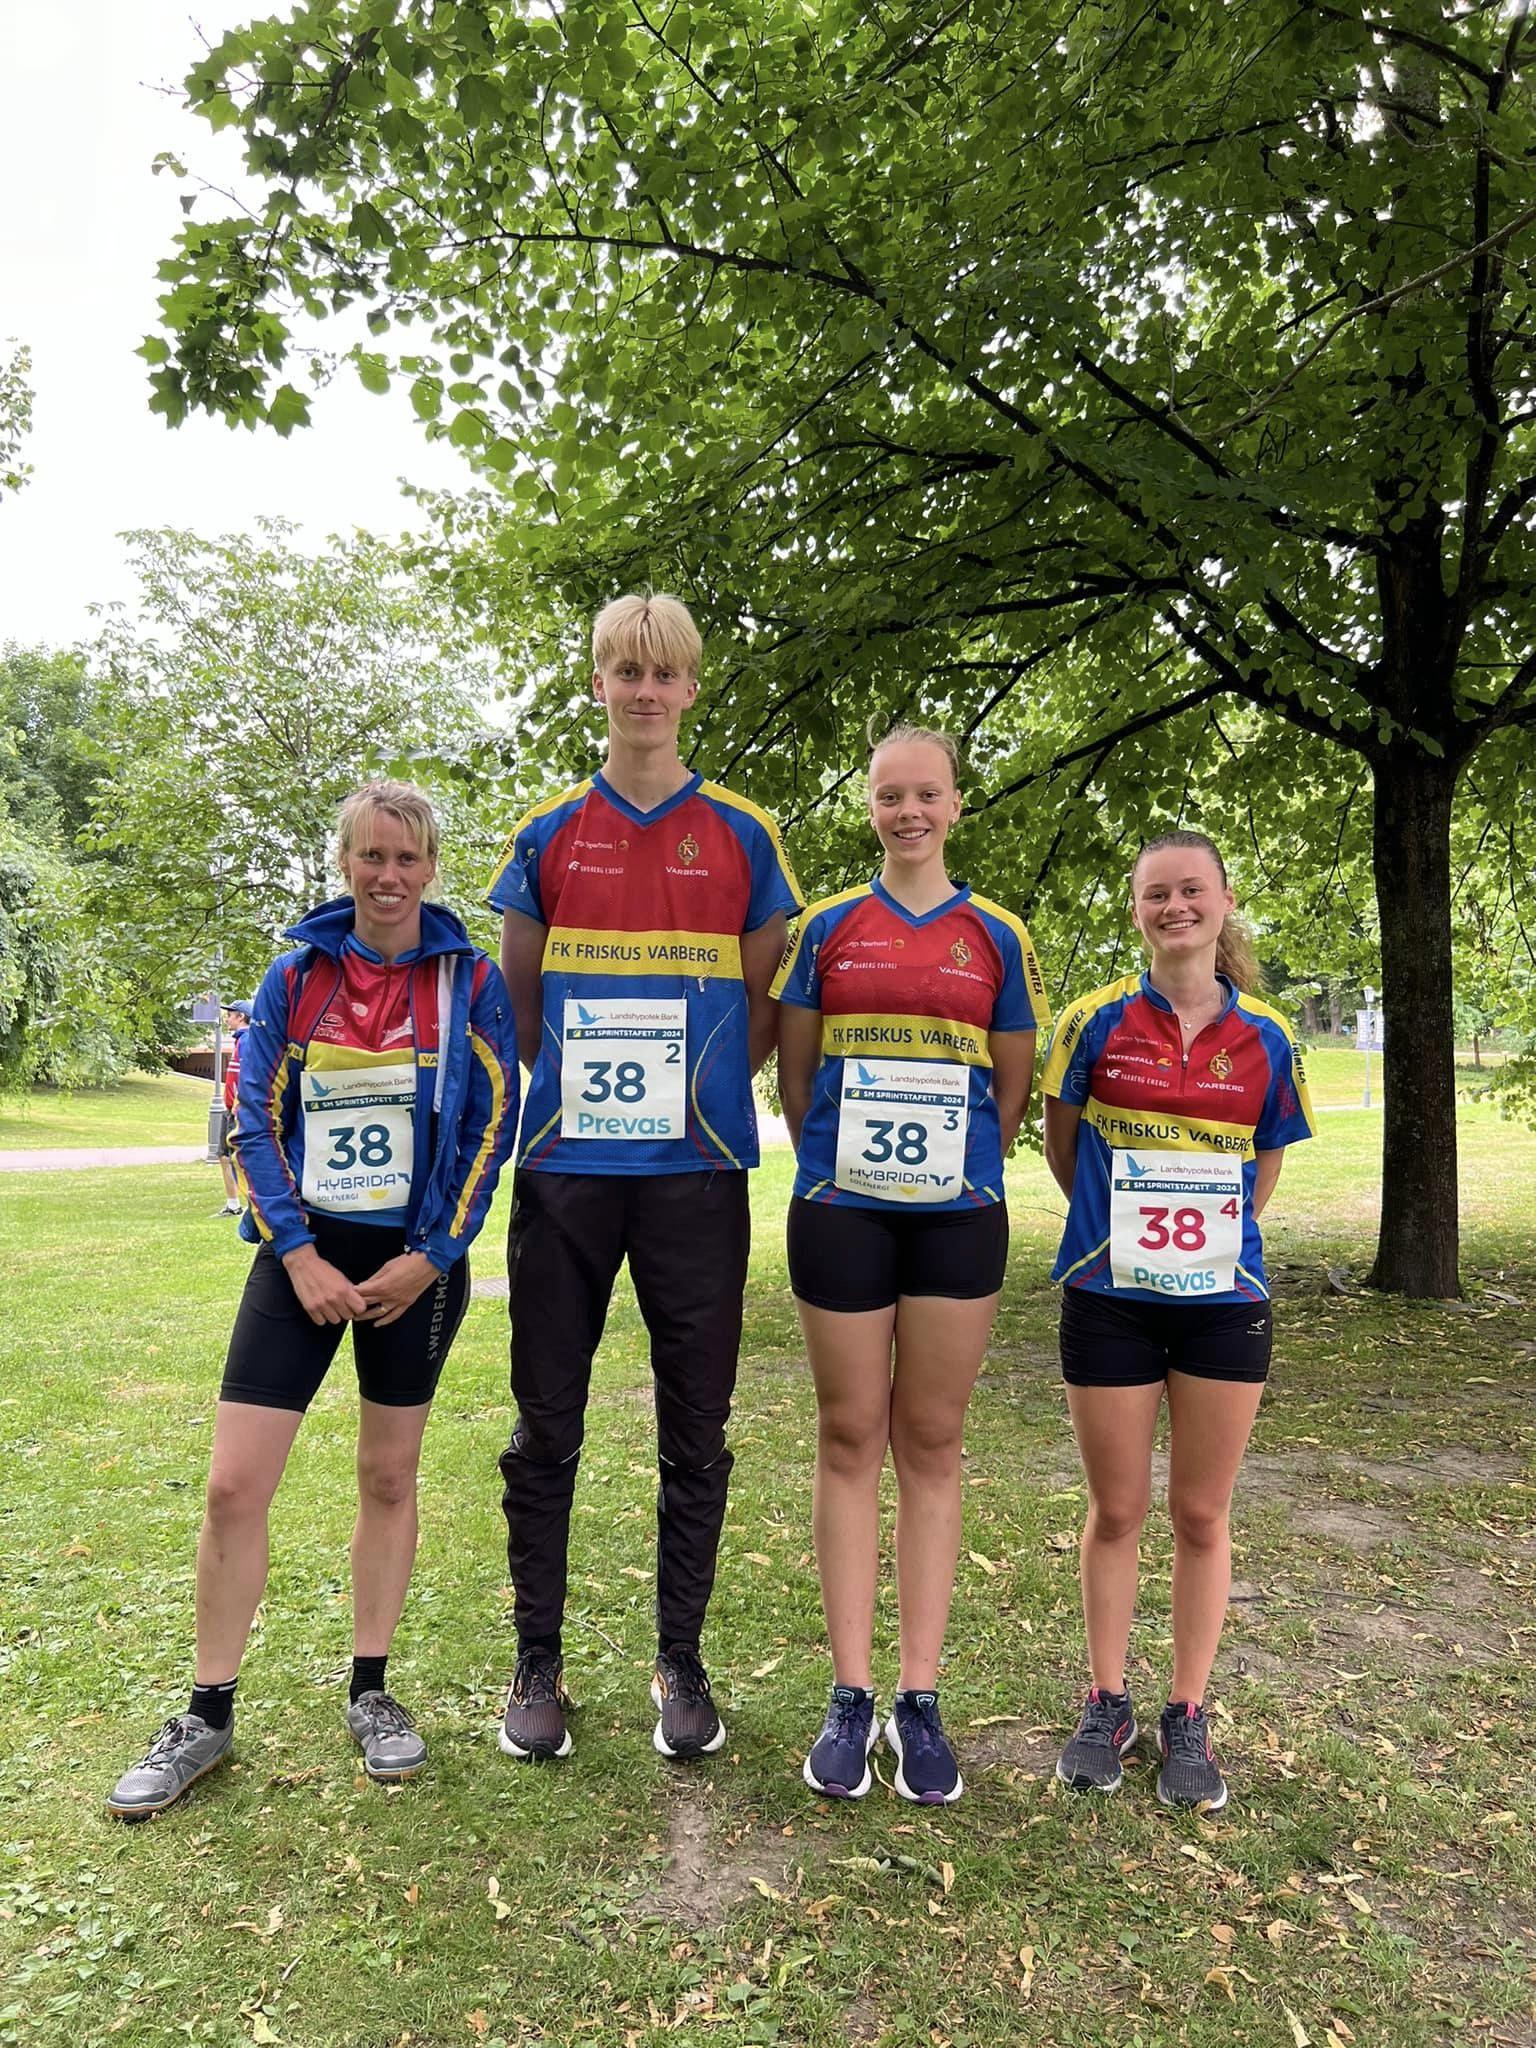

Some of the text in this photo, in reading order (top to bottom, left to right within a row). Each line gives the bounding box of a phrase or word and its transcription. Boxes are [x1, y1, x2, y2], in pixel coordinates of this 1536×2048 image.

[665, 866, 709, 876] VARBERG
[551, 942, 719, 962] FK FRISKUS VARBERG
[939, 966, 983, 981] VARBERG
[1027, 951, 1044, 995] TRIMTEX
[610, 1012, 660, 1021] Landshypotek
[1062, 1008, 1086, 1048] TRIMTEX
[833, 1026, 979, 1054] FK FRISKUS VARBERG
[665, 1043, 681, 1063] 2
[1106, 1053, 1154, 1065] VATTENFALL
[394, 1077, 413, 1086] Bank
[580, 1061, 646, 1103] 38
[890, 1075, 960, 1086] Landshypotek Bank
[1196, 1082, 1245, 1092] VARBERG
[335, 1096, 392, 1107] SPRINTSTAFETT
[876, 1091, 937, 1102] SPRINTSTAFETT
[942, 1096, 961, 1104] 2024
[578, 1112, 671, 1134] Prevas
[942, 1109, 959, 1131] 3
[861, 1119, 928, 1165] 38
[1110, 1119, 1180, 1139] FRISKUS
[1188, 1128, 1251, 1152] VARBERG
[327, 1124, 392, 1170] 38
[849, 1167, 927, 1184] HYBRIDA
[1160, 1165, 1232, 1175] Landshypotek Bank
[317, 1173, 396, 1191] HYBRIDA
[1133, 1181, 1146, 1189] SM
[1147, 1182, 1210, 1190] SPRINTSTAFETT
[1220, 1197, 1239, 1219] 4
[1137, 1206, 1206, 1251] 38
[1134, 1266, 1216, 1291] Prevas
